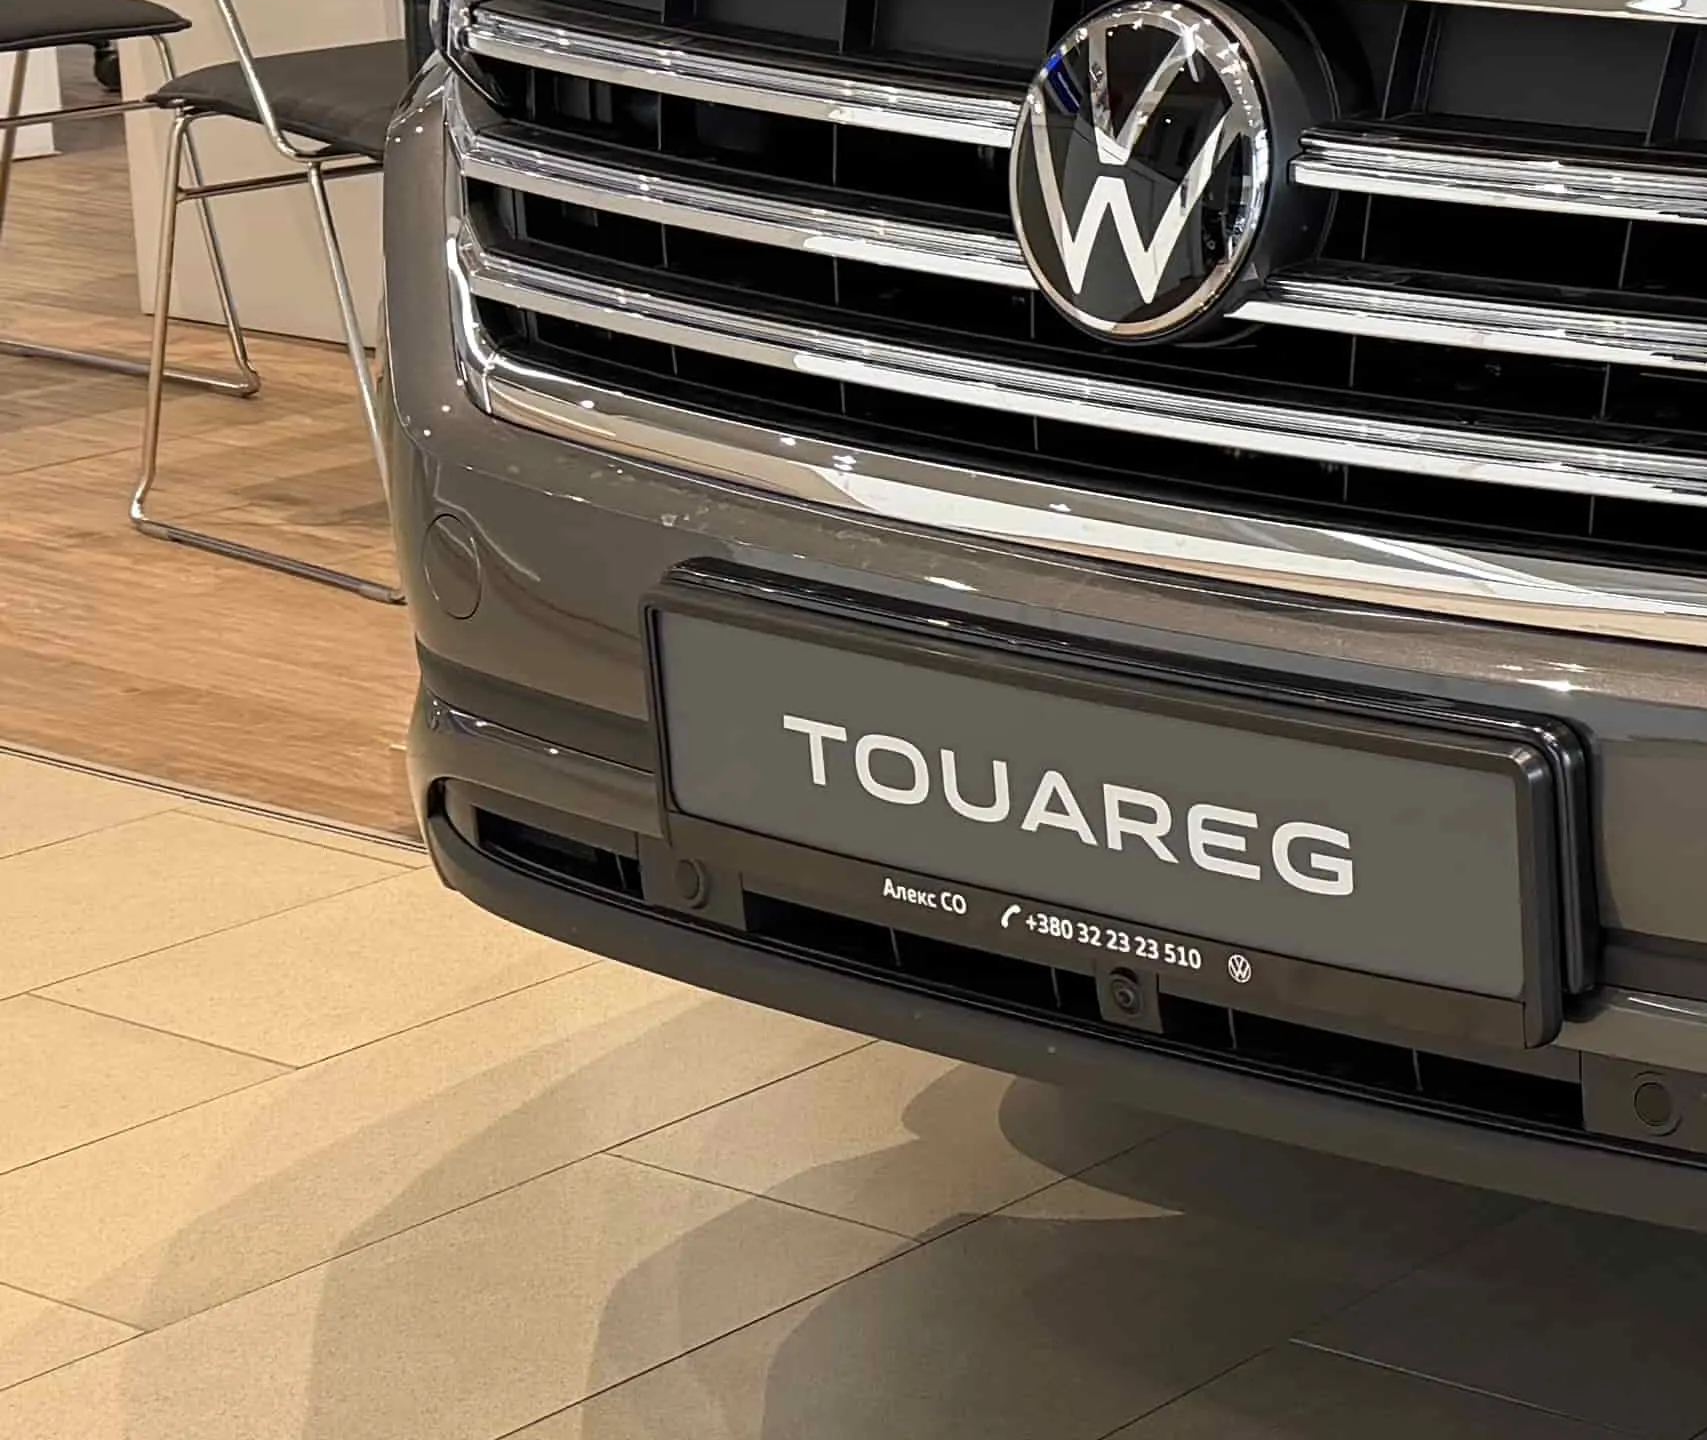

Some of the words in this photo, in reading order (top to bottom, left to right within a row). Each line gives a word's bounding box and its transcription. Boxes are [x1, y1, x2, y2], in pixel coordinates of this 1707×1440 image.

[782, 713, 1354, 896] TOUAREG
[882, 877, 937, 909] Алекс
[939, 890, 968, 915] СО
[1025, 912, 1074, 941] +380
[1077, 922, 1102, 947] 32
[1105, 929, 1131, 953] 23
[1135, 936, 1160, 960] 23
[1163, 946, 1202, 970] 510
